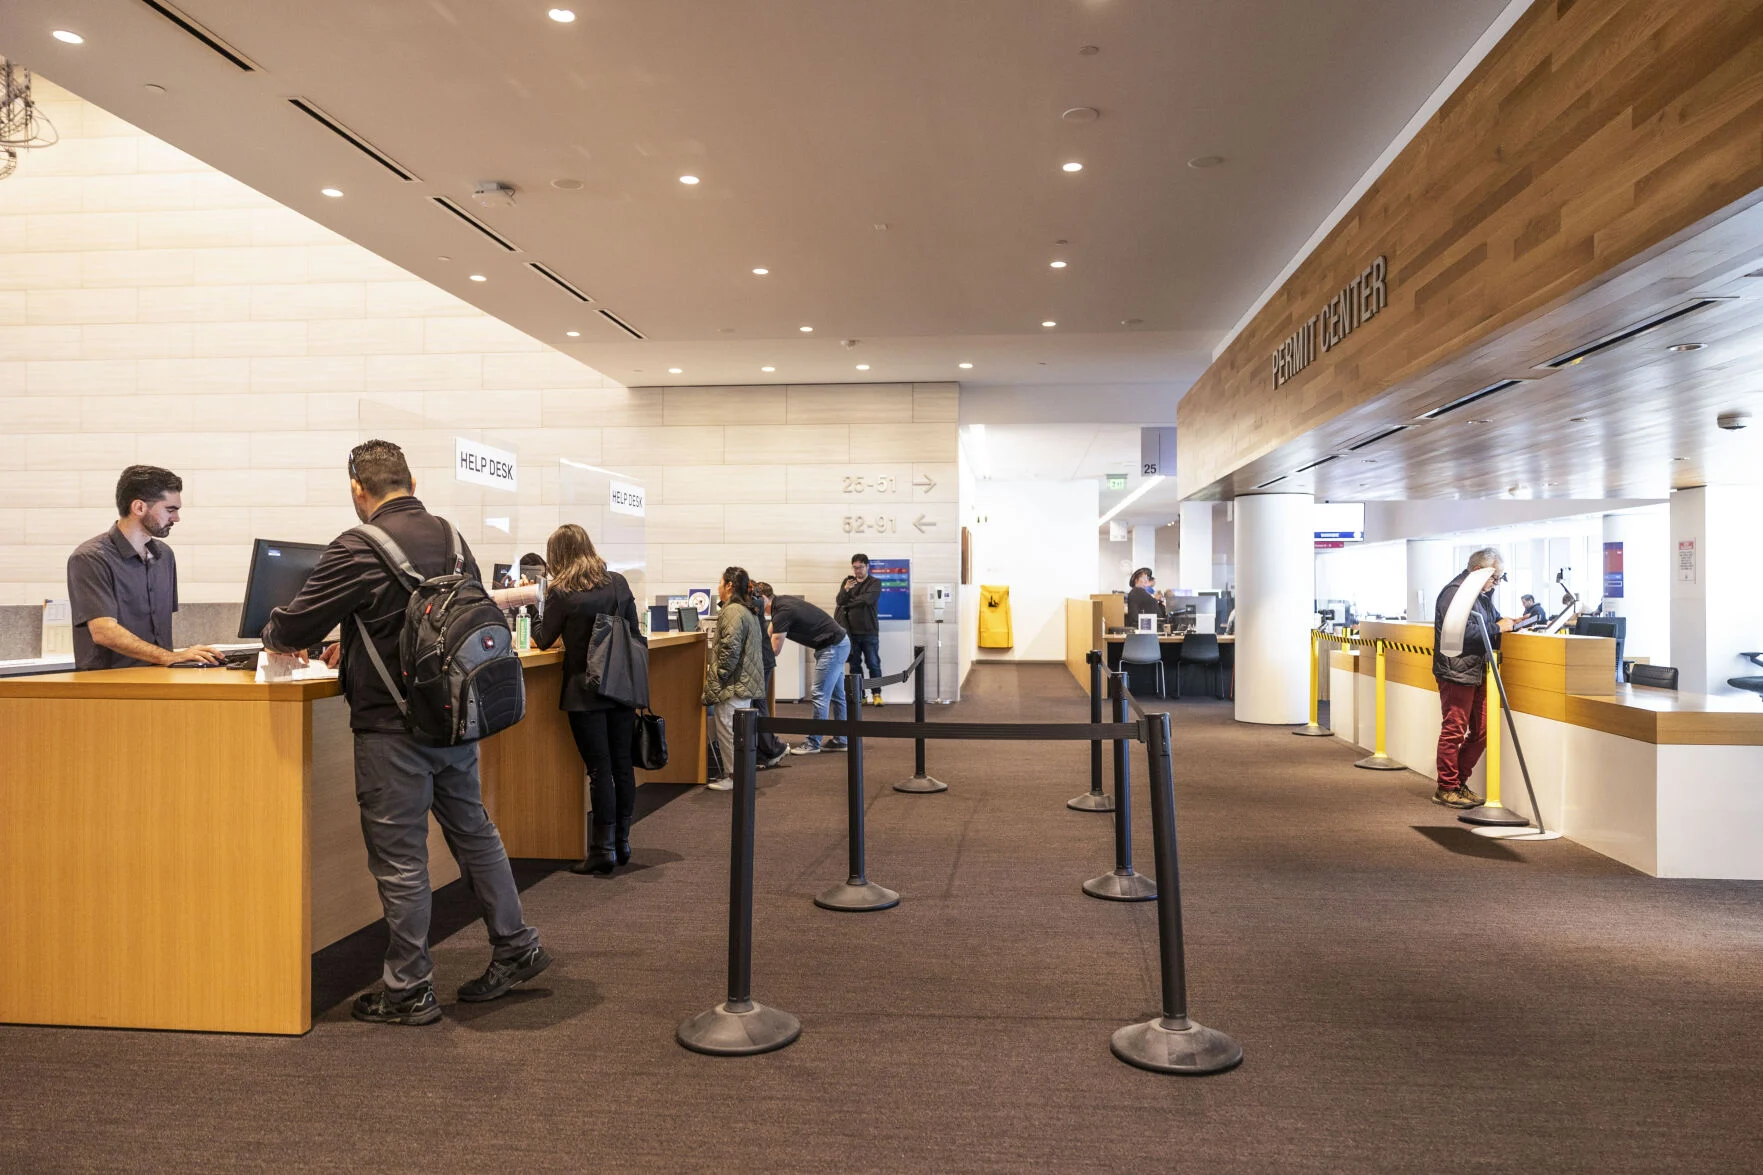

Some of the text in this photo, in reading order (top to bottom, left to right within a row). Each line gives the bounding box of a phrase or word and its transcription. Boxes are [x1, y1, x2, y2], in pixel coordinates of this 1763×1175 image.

[1272, 255, 1387, 391] PERMIT CENTER
[460, 451, 514, 480] HELP DESK
[1143, 463, 1157, 474] 25
[842, 475, 897, 494] 25-51
[612, 490, 643, 508] HELP DESK
[842, 515, 897, 534] 52-91
